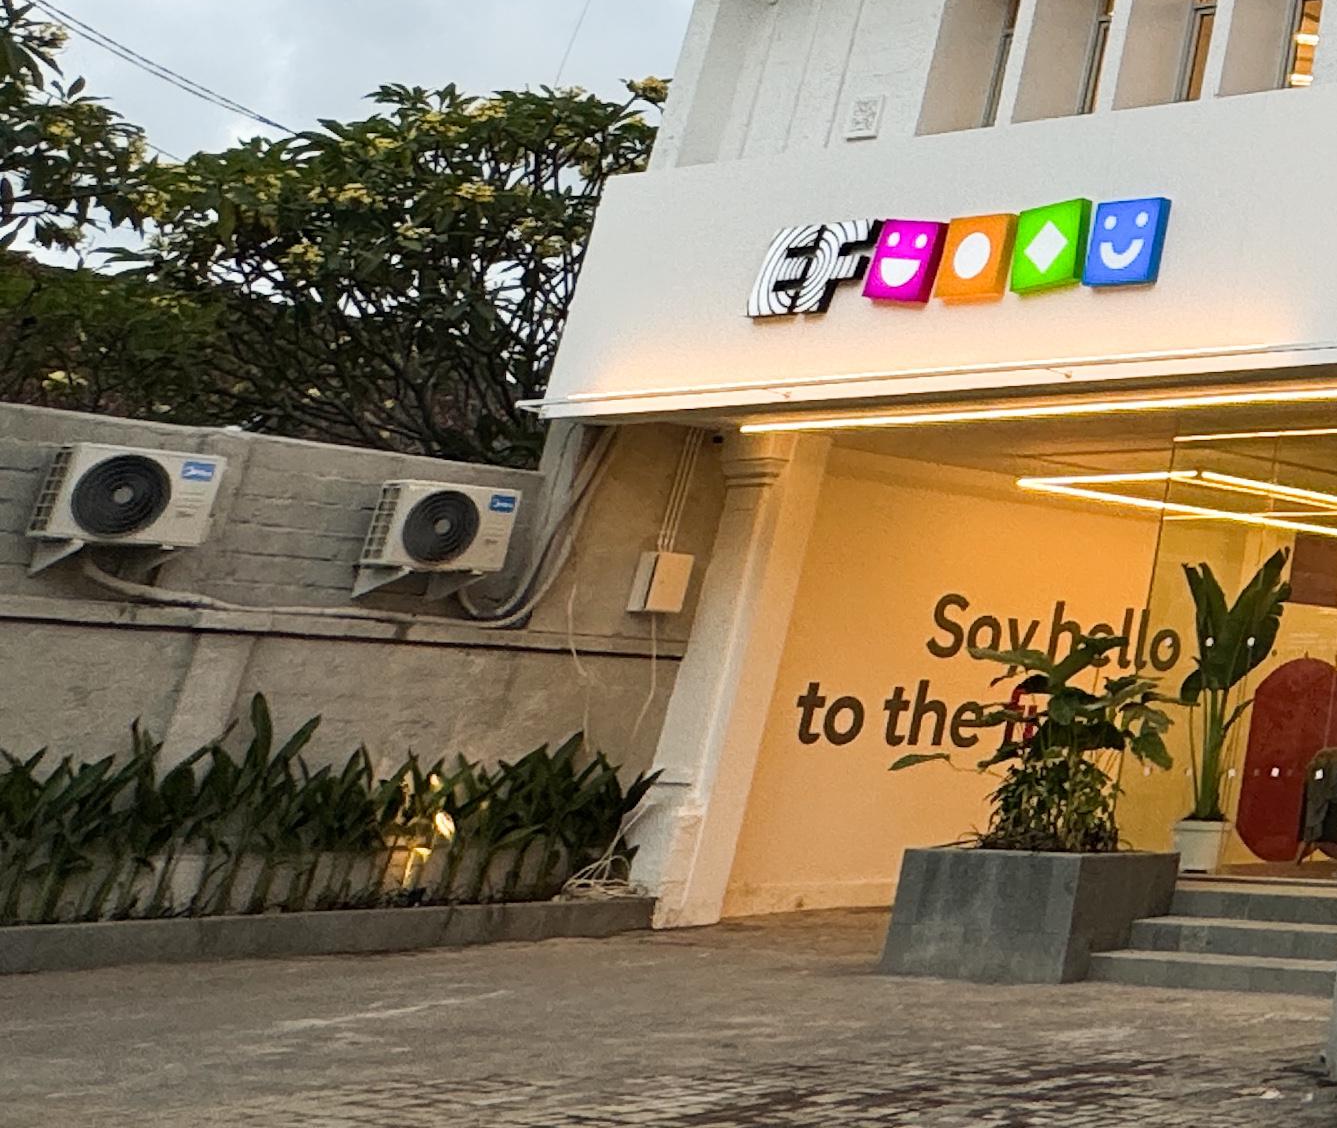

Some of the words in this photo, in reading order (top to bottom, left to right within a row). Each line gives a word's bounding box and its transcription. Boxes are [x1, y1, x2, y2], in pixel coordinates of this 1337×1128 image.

[747, 218, 884, 317] EF
[926, 593, 1040, 680] Say
[1048, 600, 1181, 672] hello
[797, 681, 865, 747] to
[883, 679, 980, 748] the
